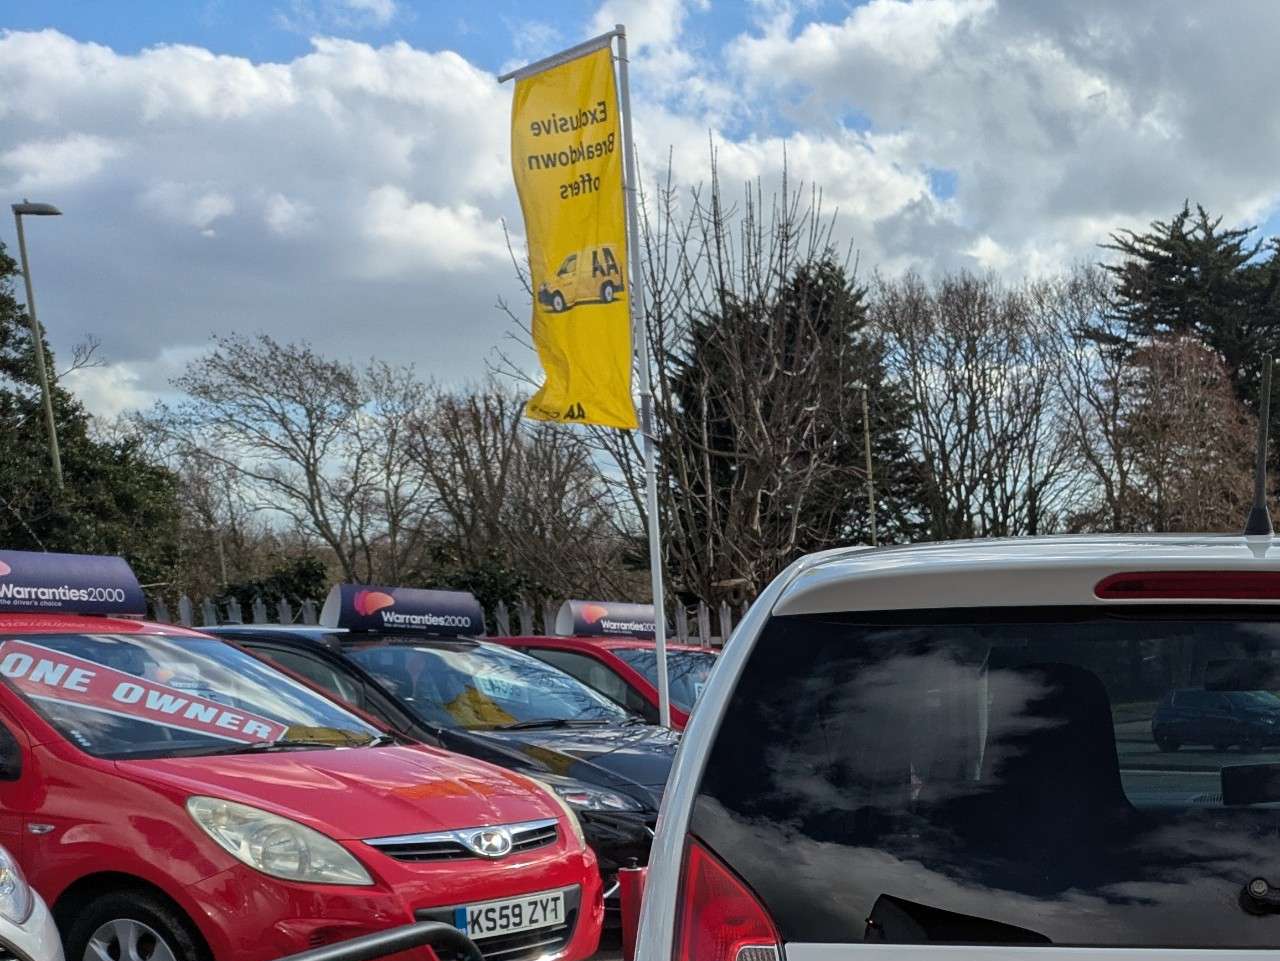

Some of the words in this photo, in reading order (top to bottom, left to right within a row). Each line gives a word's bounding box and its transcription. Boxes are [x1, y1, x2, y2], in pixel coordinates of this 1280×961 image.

[40, 599, 62, 607] choice
[381, 611, 472, 628] Warranties2000
[601, 619, 657, 632] Warranties200
[0, 652, 96, 693] ONE
[112, 682, 272, 740] OWNER
[469, 904, 523, 934] KS59
[527, 896, 561, 925] ZYT
